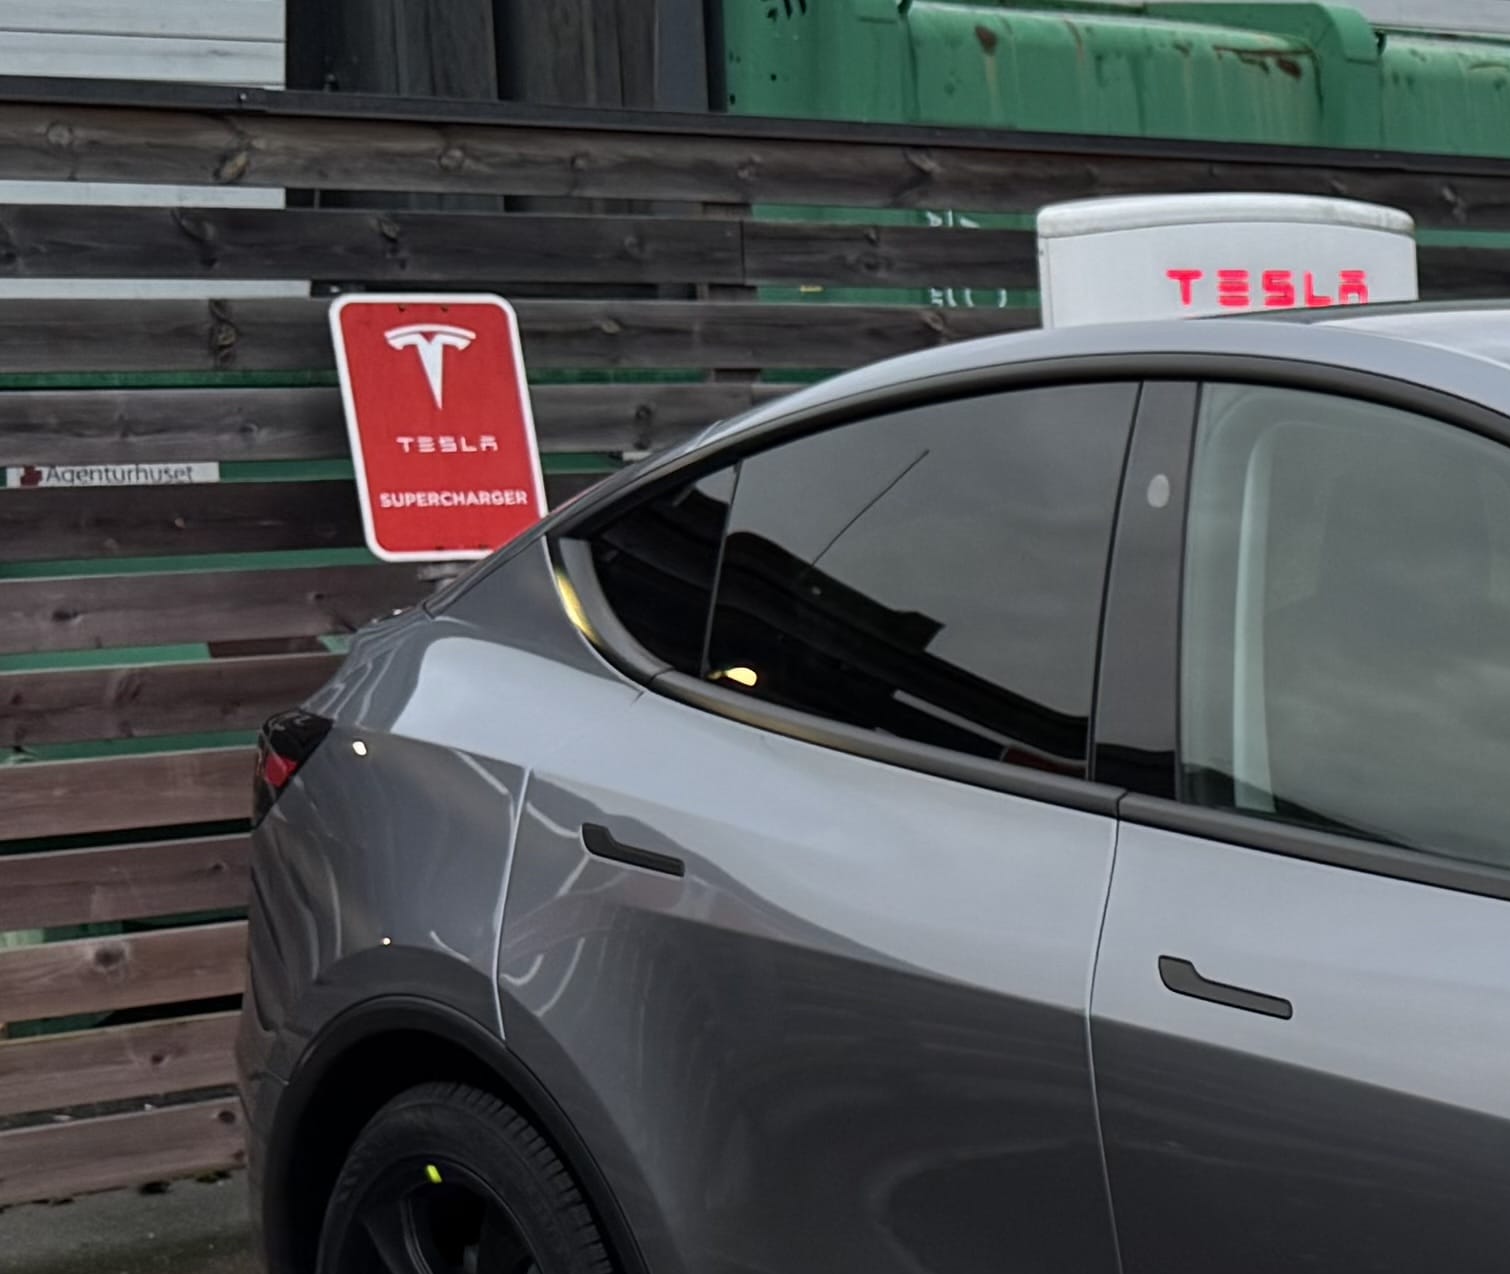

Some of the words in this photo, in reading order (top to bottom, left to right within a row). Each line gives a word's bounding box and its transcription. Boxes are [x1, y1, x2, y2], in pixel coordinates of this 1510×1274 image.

[1165, 269, 1370, 308] TESLA
[396, 435, 498, 453] TESLA
[46, 463, 193, 485] Agenturhuset
[379, 488, 528, 508] SUPERCHARGER
